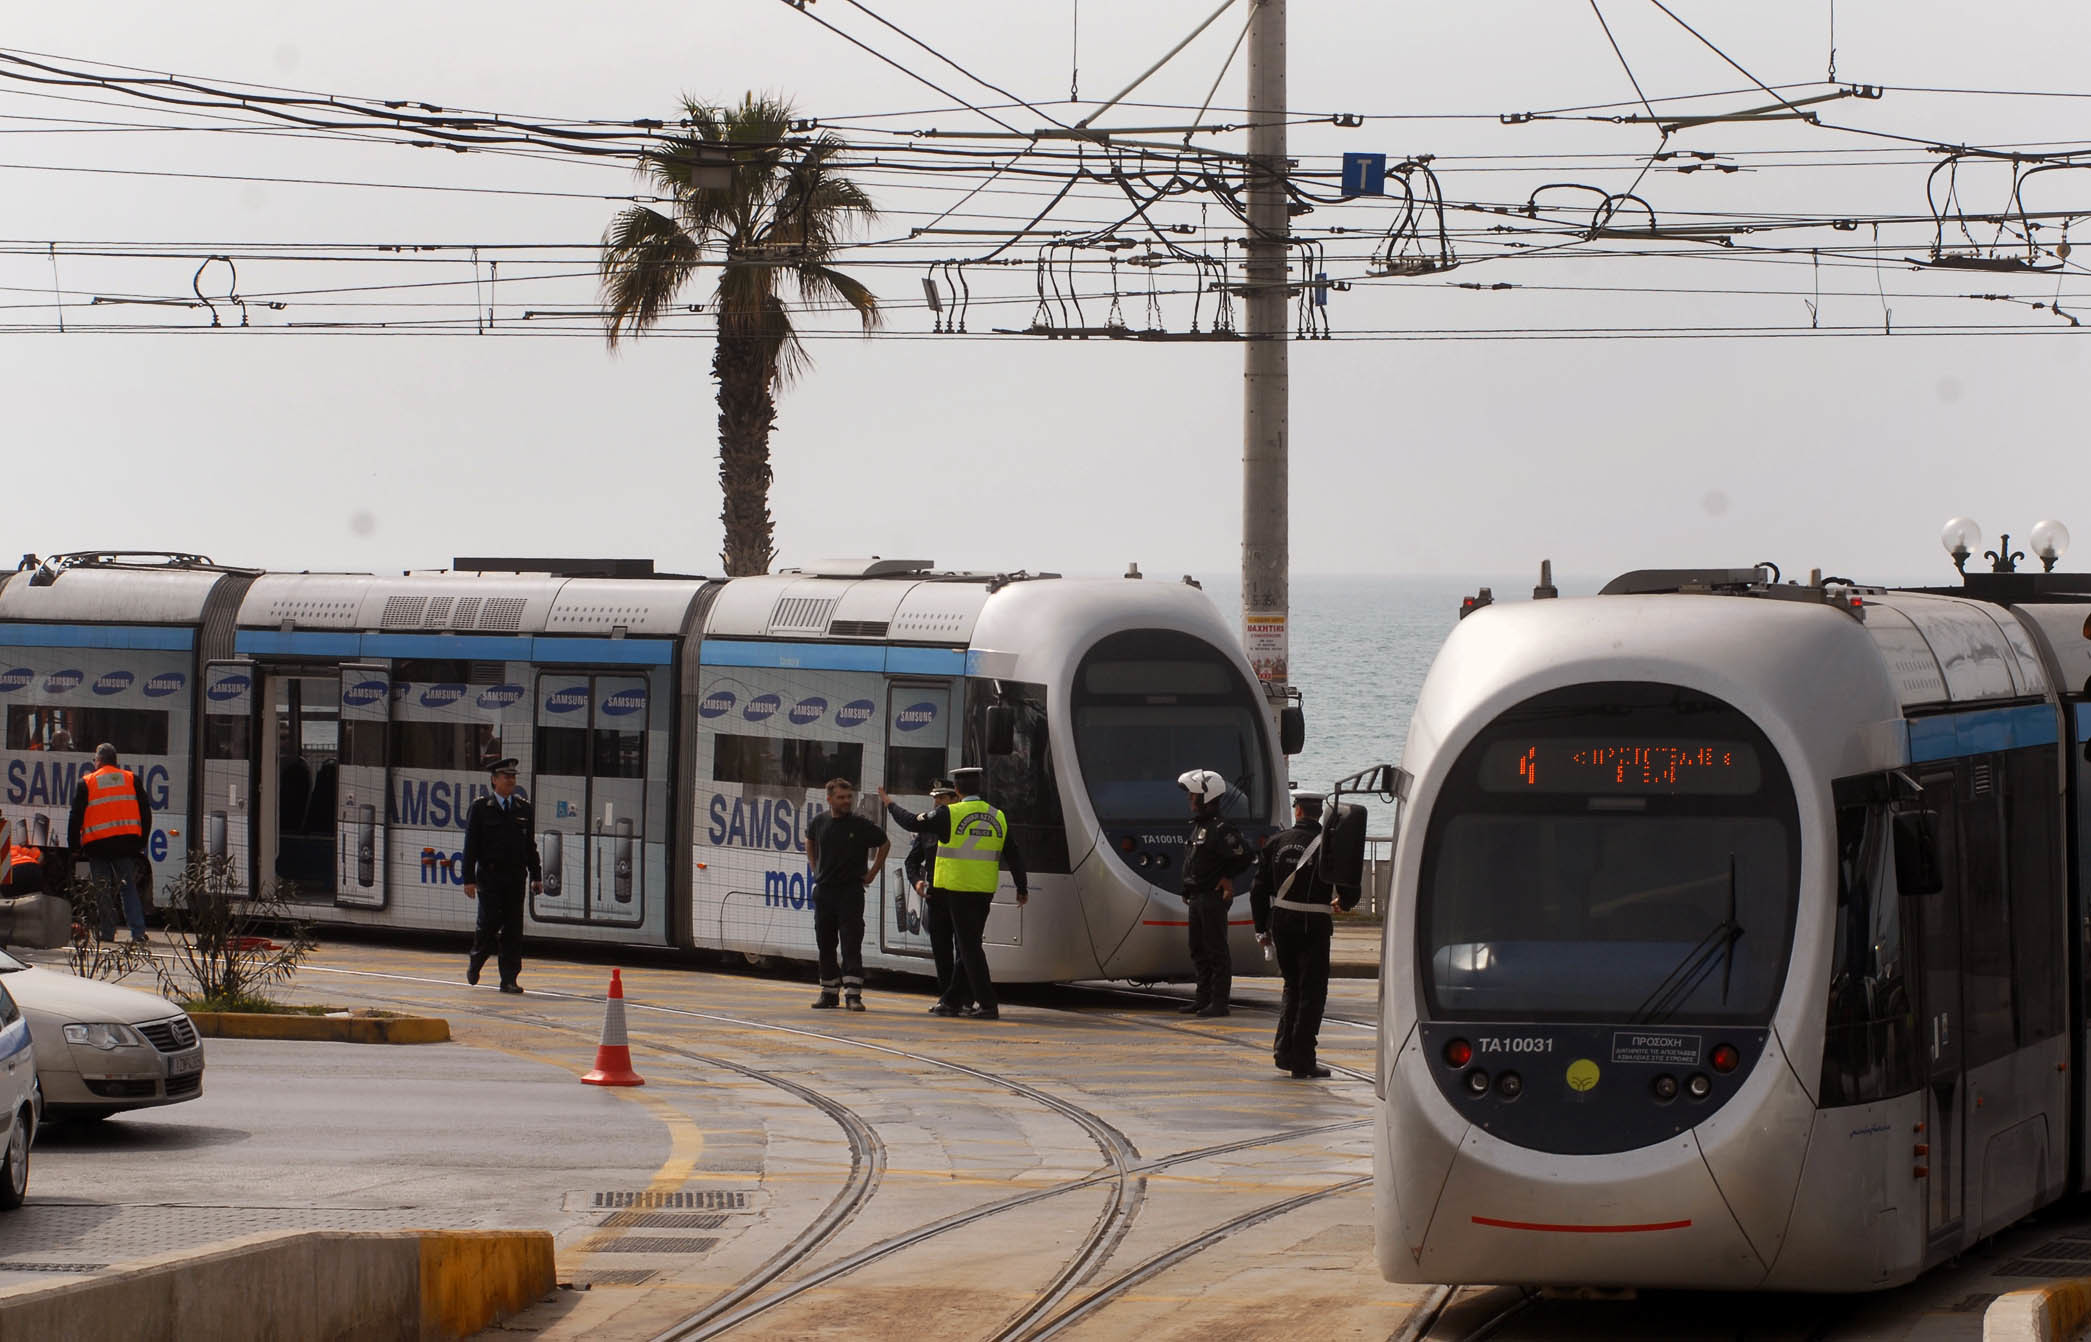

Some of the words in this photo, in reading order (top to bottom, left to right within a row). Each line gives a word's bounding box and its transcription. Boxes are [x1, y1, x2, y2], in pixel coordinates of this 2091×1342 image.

[47, 676, 79, 687] SAMSUNG
[97, 678, 130, 688] SAMSUNG
[147, 679, 183, 690] SAMSUNG
[213, 682, 246, 693] SAMSUNG
[348, 687, 384, 699] SAMSUNG
[426, 689, 462, 701] SAMSUNG
[482, 691, 518, 702] SAMSUNG
[551, 694, 588, 706] SAMSUNG
[608, 697, 646, 709] SAMSUNG
[703, 698, 733, 711] SAMSUNG
[747, 702, 777, 715] SAMSUNG
[793, 705, 824, 718] SAMSUNG
[840, 708, 872, 720] SAMSUNG
[900, 711, 932, 723] SAMSUNG
[7, 759, 169, 811] SAMG
[708, 793, 827, 852] SAMSU
[765, 862, 816, 910] mob
[1479, 1038, 1553, 1052] TA10031
[1632, 1036, 1682, 1047] ΠΡΟΣΟΧΗ
